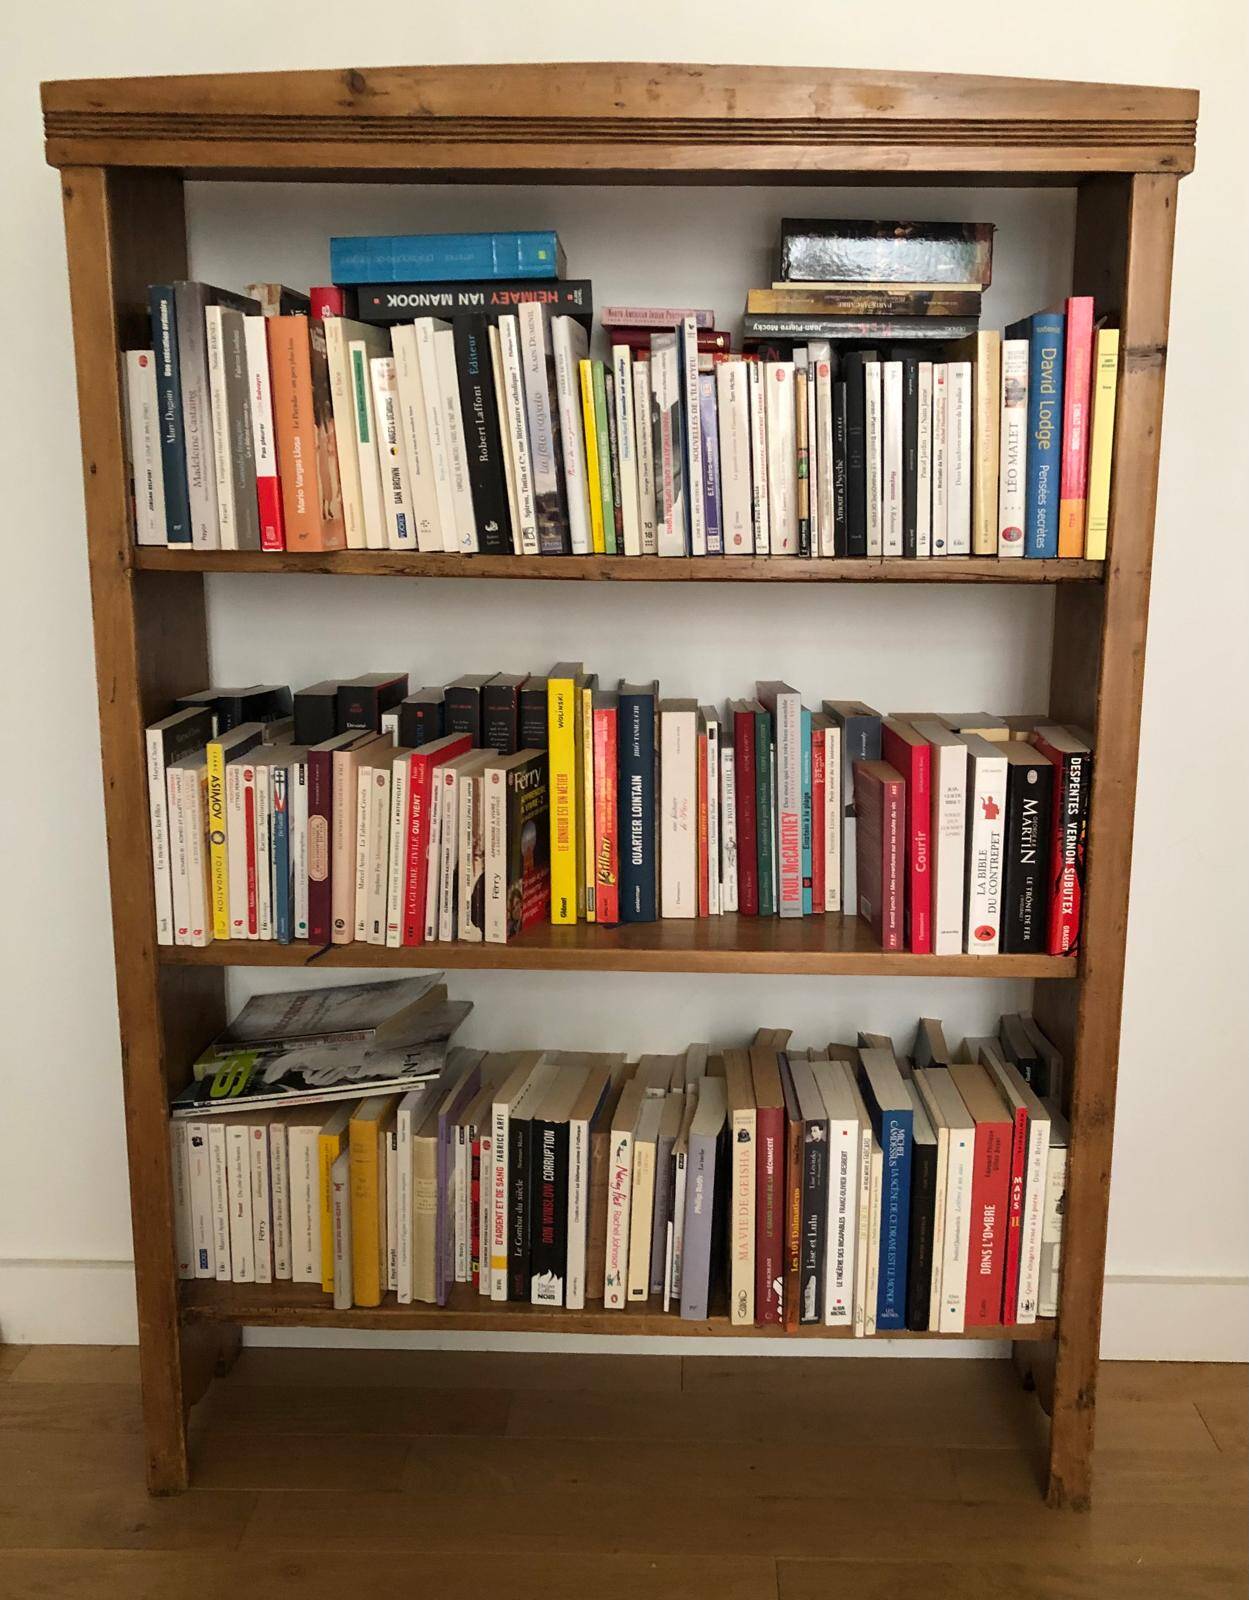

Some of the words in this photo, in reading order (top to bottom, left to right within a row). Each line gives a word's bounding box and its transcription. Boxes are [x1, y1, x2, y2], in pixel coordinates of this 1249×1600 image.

[386, 293, 453, 307] MANOOK
[459, 293, 485, 305] IAN
[490, 290, 559, 304] HEIMAEY
[753, 322, 779, 333] Mocky
[781, 323, 823, 333] Jean-Pierre
[162, 331, 171, 363] exécution
[467, 334, 479, 375] Éditeur
[1040, 348, 1056, 394] David
[511, 373, 522, 406] catholique
[164, 390, 176, 421] Dugain
[187, 390, 199, 433] Castaing
[472, 385, 485, 424] Laffont
[691, 402, 698, 414] DE
[165, 423, 176, 444] Marc
[259, 423, 267, 447] pleurer
[513, 406, 524, 440] littérature
[920, 425, 927, 434] Le
[1034, 400, 1056, 450] Lodge
[292, 436, 301, 458] Llosa
[387, 426, 397, 445] ANGES
[475, 427, 488, 462] Robert
[1008, 423, 1019, 466] MALET
[190, 435, 202, 488] Madeleine
[295, 459, 305, 487] Vargas
[835, 459, 845, 487] Psyché
[391, 467, 401, 490] BROWN
[520, 473, 529, 493] Tintin
[1005, 468, 1018, 493] LÉO
[1038, 465, 1050, 506] Pensées
[296, 489, 305, 513] Mario
[393, 491, 403, 504] DAN
[523, 494, 532, 518] Spirou,
[835, 495, 844, 523] Amour
[1036, 508, 1048, 549] secrètes
[556, 693, 565, 729] WOLINSKI
[514, 768, 542, 792] Ferry
[555, 773, 568, 795] MÉTIER
[1068, 757, 1082, 815] DESPENTES
[210, 775, 222, 819] ASIMOV
[412, 793, 422, 817] VIENT
[556, 796, 567, 805] UN
[631, 775, 643, 818] LOINTAIN
[803, 791, 811, 809] plage
[154, 803, 162, 818] filles
[556, 806, 568, 816] EST
[412, 819, 421, 834] QUI
[557, 817, 568, 844] BONHEUR
[802, 823, 810, 850] Einstein
[1020, 799, 1038, 864] MARTIN
[359, 839, 366, 847] La
[411, 835, 419, 865] CIVILE
[558, 844, 568, 852] LE
[631, 820, 644, 865] QUARTIER
[780, 812, 799, 874] McCARTNEY
[915, 831, 927, 873] Courir
[1065, 821, 1078, 864] VERNON
[597, 836, 613, 885] Vaillant
[978, 849, 987, 879] BIBLE
[989, 831, 1000, 896] CONTREPET
[214, 856, 225, 912] FOUNDATION
[410, 866, 418, 901] GUERRE
[492, 873, 501, 901] Ferry
[782, 876, 799, 902] PAUL
[977, 882, 986, 896] LA
[1025, 876, 1033, 885] LE
[1062, 867, 1075, 915] SUBUTEX
[409, 901, 417, 914] LA
[560, 897, 568, 918] Glénat
[988, 898, 997, 914] DU
[1025, 887, 1035, 912] TRÔNE
[1024, 914, 1032, 925] DE
[1061, 925, 1070, 951] GRASSET
[496, 1114, 504, 1131] ARFI
[495, 1134, 504, 1163] FABRICE
[888, 1119, 898, 1166] CAMDESSUS
[896, 1127, 905, 1156] MICHEL
[986, 1130, 994, 1152] Philippe
[1033, 1128, 1042, 1155] Brissac
[543, 1130, 556, 1182] CORRUPTION
[766, 1138, 774, 1175] MÉCHANCETÉ
[840, 1150, 848, 1175] GIESBERT
[1034, 1157, 1041, 1167] de
[495, 1167, 504, 1188] SANG
[696, 1175, 704, 1193] Roth
[739, 1150, 750, 1197] GEISHA
[891, 1167, 899, 1178] LA
[1032, 1169, 1041, 1183] Duc
[495, 1189, 504, 1199] DE
[514, 1179, 523, 1201] siècle
[839, 1177, 847, 1214] FRANZ-OLIVIER
[495, 1201, 504, 1210] ET
[514, 1204, 523, 1214] du
[542, 1184, 555, 1225] WINSLOW
[694, 1194, 703, 1215] Philip
[739, 1200, 749, 1217] DE
[790, 1188, 800, 1239] Dalmatiens
[890, 1201, 898, 1212] DE
[1031, 1194, 1039, 1213] porte
[258, 1220, 266, 1241] Ferry
[495, 1211, 504, 1246] D'ARGENT
[613, 1209, 621, 1235] Rachel
[739, 1220, 749, 1240] VIE
[807, 1215, 818, 1237] Lulu
[889, 1213, 898, 1224] CE
[981, 1205, 995, 1248] L'OMBRE
[514, 1216, 523, 1246] Combat
[541, 1226, 554, 1244] DON
[837, 1216, 845, 1247] INCAPABLES
[514, 1248, 523, 1258] Le
[611, 1236, 621, 1269] Johnson
[739, 1242, 749, 1261] MA
[790, 1241, 799, 1256] 101
[808, 1239, 817, 1249] et
[887, 1247, 896, 1265] EST
[790, 1258, 799, 1273] Les
[806, 1250, 817, 1269] Lise
[836, 1259, 844, 1281] THÉÂTRE
[887, 1265, 895, 1276] LE
[980, 1250, 993, 1275] DANS
[1026, 1246, 1036, 1272] chagrin
[886, 1277, 896, 1303] MONDE
[1025, 1281, 1033, 1295] Que
